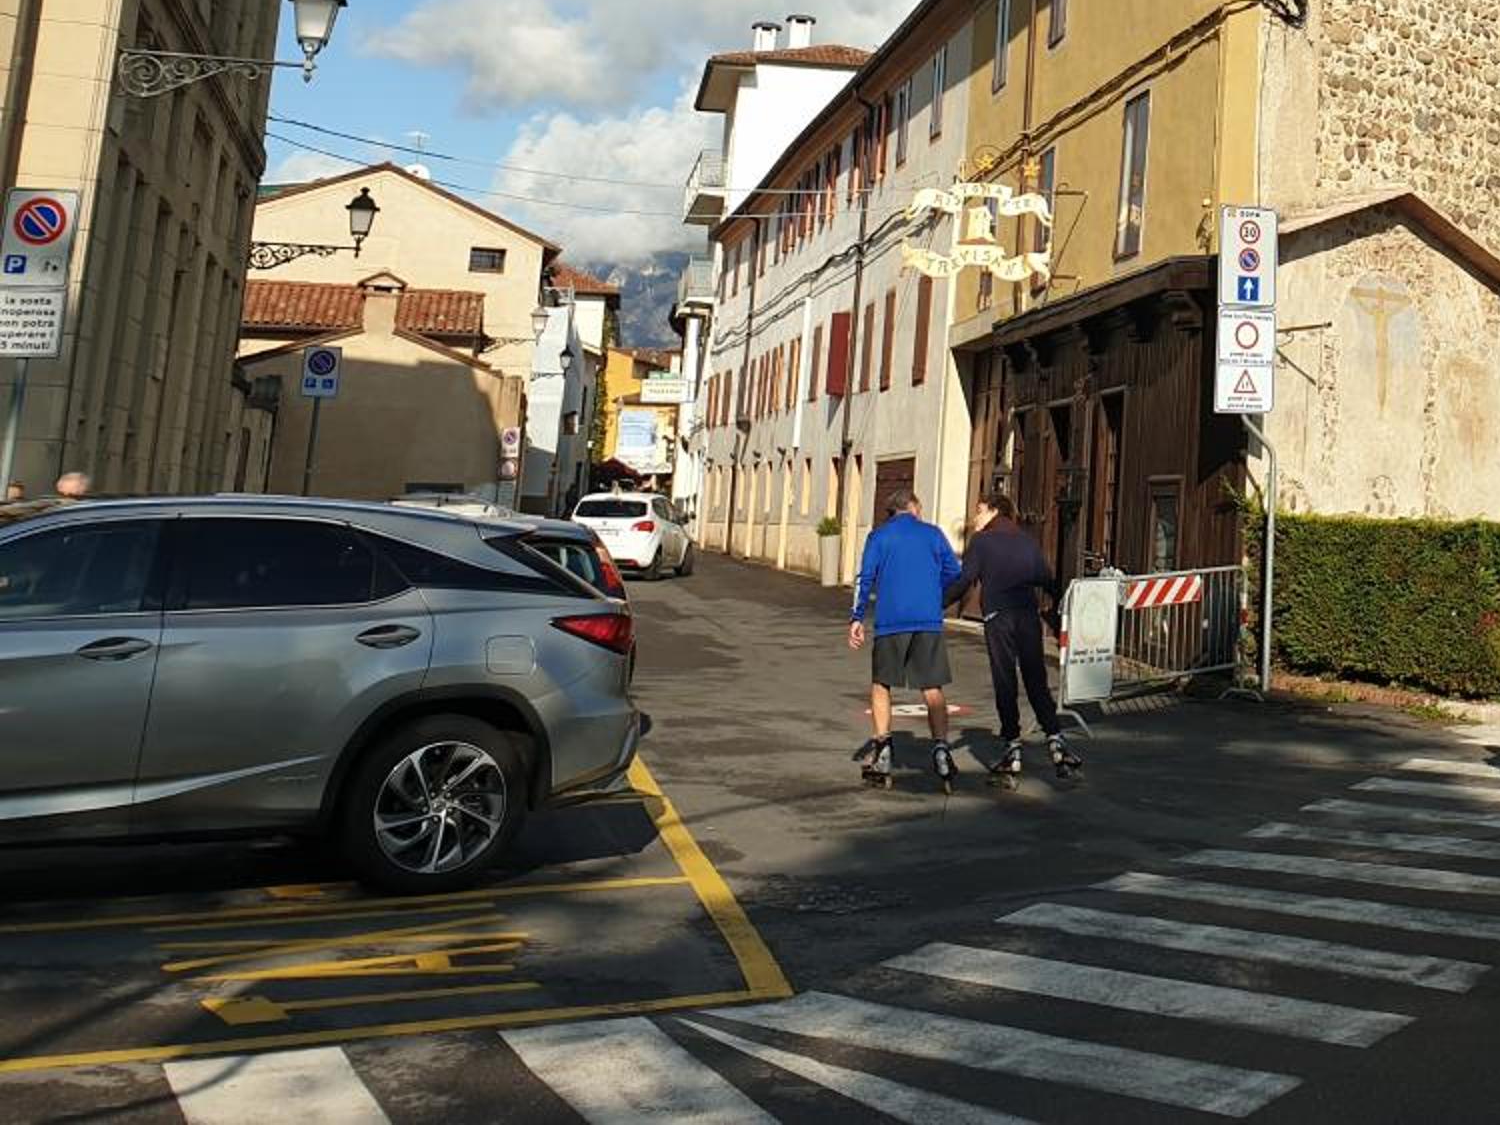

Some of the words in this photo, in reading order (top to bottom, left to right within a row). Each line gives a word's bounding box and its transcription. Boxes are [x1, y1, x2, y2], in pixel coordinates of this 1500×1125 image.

[7, 256, 23, 272] P
[926, 250, 1030, 274] TREVISANI
[20, 297, 52, 305] sosta
[0, 308, 56, 317] noperosa
[0, 331, 47, 339] uperare
[10, 341, 51, 350] minuti
